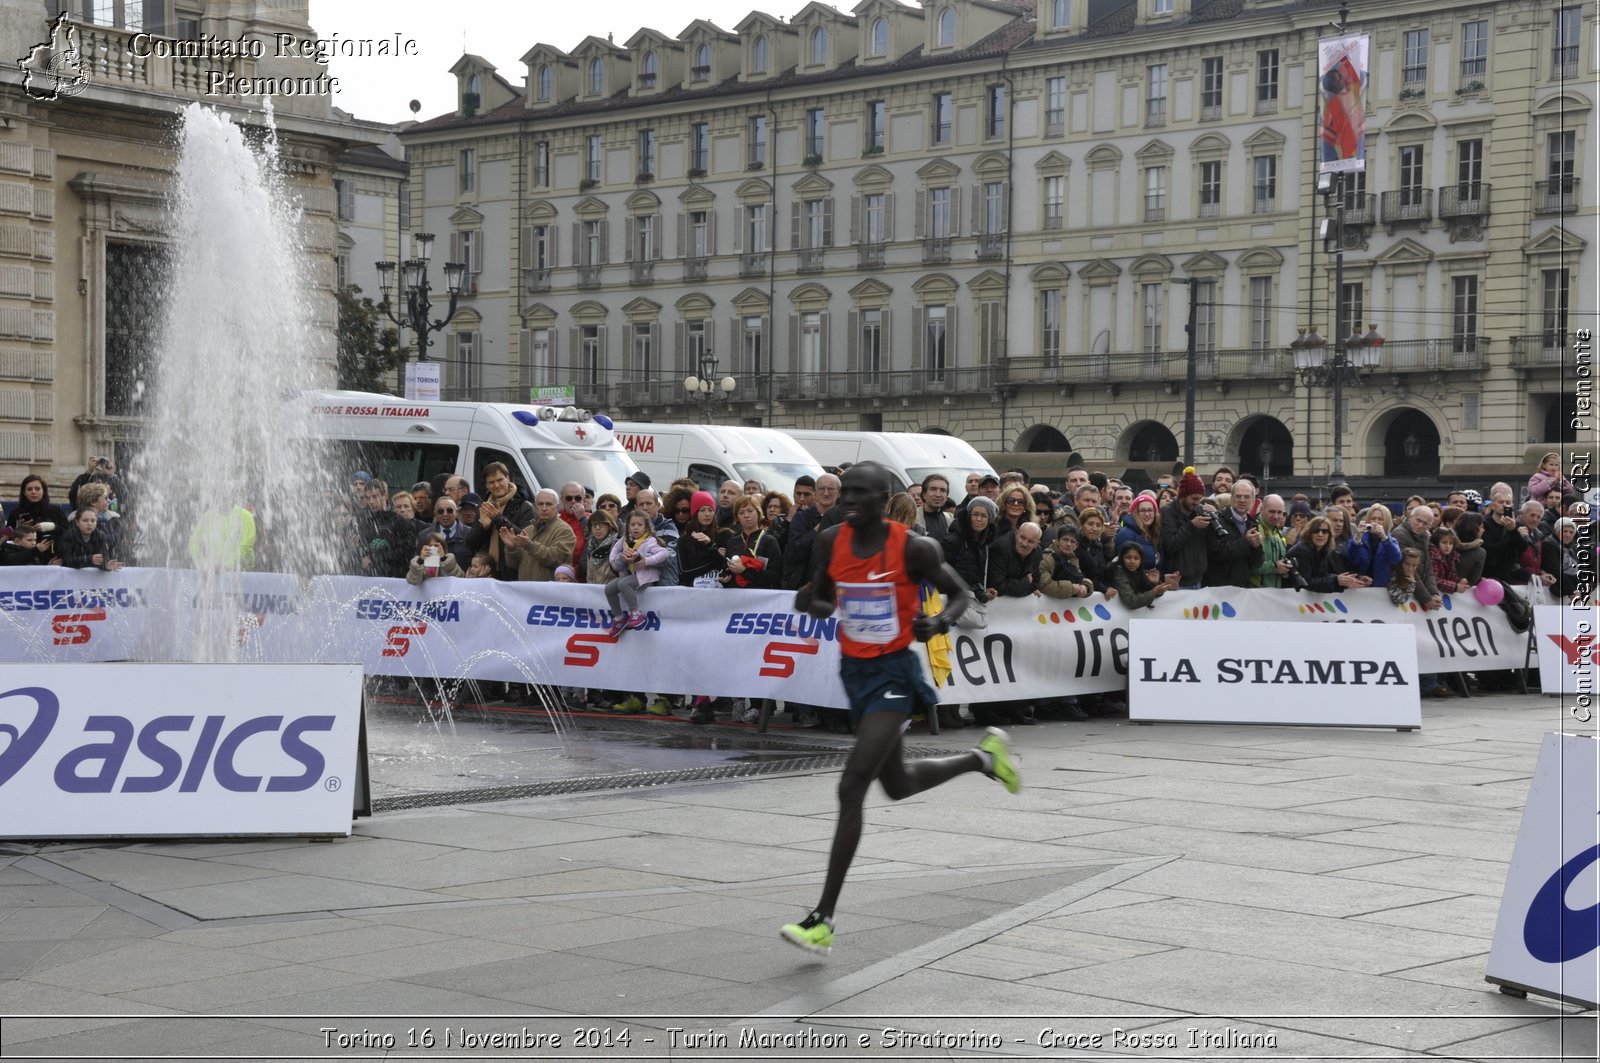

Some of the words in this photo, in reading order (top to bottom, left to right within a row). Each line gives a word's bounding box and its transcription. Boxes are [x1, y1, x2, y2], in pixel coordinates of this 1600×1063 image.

[345, 406, 378, 416] ROSSA
[381, 407, 430, 417] ITALIANA
[526, 604, 661, 631] ESSELUA
[725, 613, 842, 642] ESSELUN
[1139, 657, 1202, 683] LA
[1217, 658, 1409, 686] STAMPA
